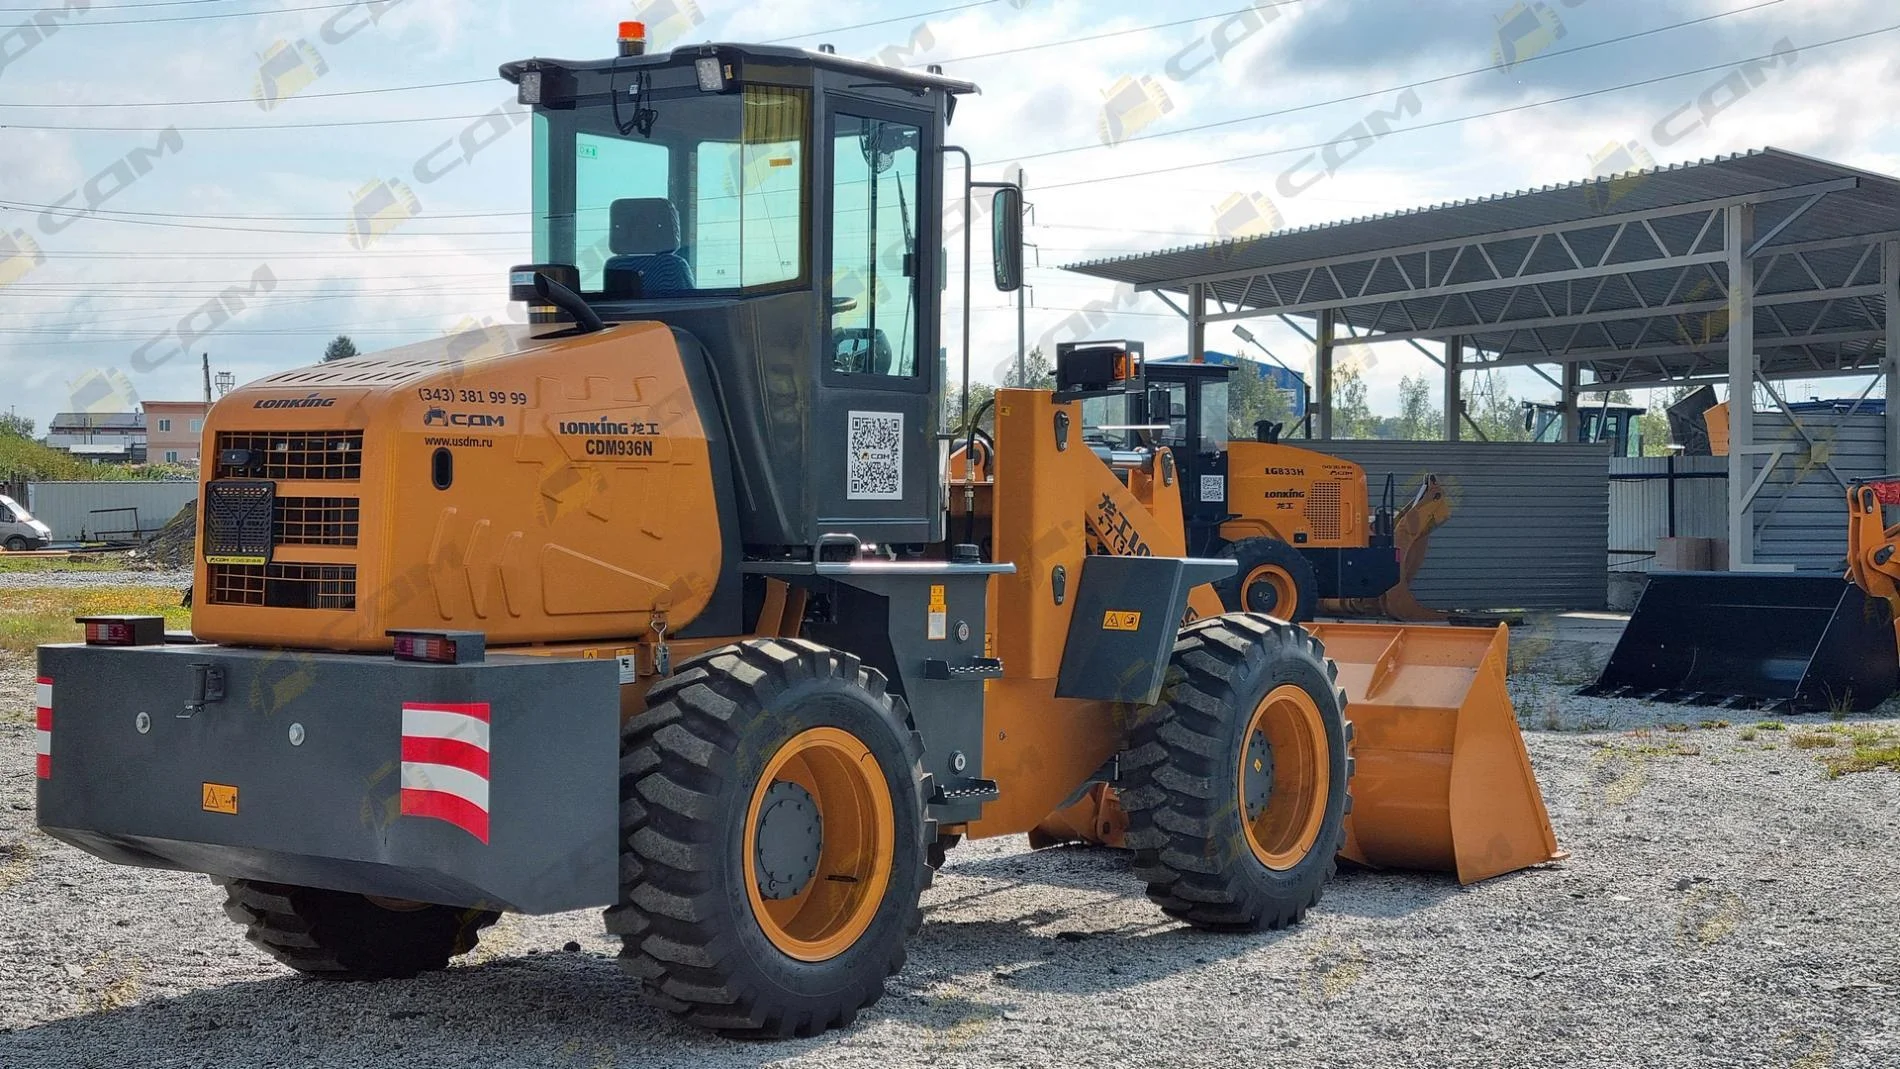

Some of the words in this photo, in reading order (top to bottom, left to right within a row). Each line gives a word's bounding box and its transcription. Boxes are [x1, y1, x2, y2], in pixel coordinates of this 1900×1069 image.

[418, 388, 455, 404] (343)
[459, 389, 485, 404] 381
[489, 391, 506, 405] 99
[510, 392, 527, 405] 99
[631, 422, 660, 435] 龙工
[424, 436, 493, 448] www.usdm.ru
[585, 439, 653, 457] CDM936N
[1264, 467, 1305, 476] LG833H
